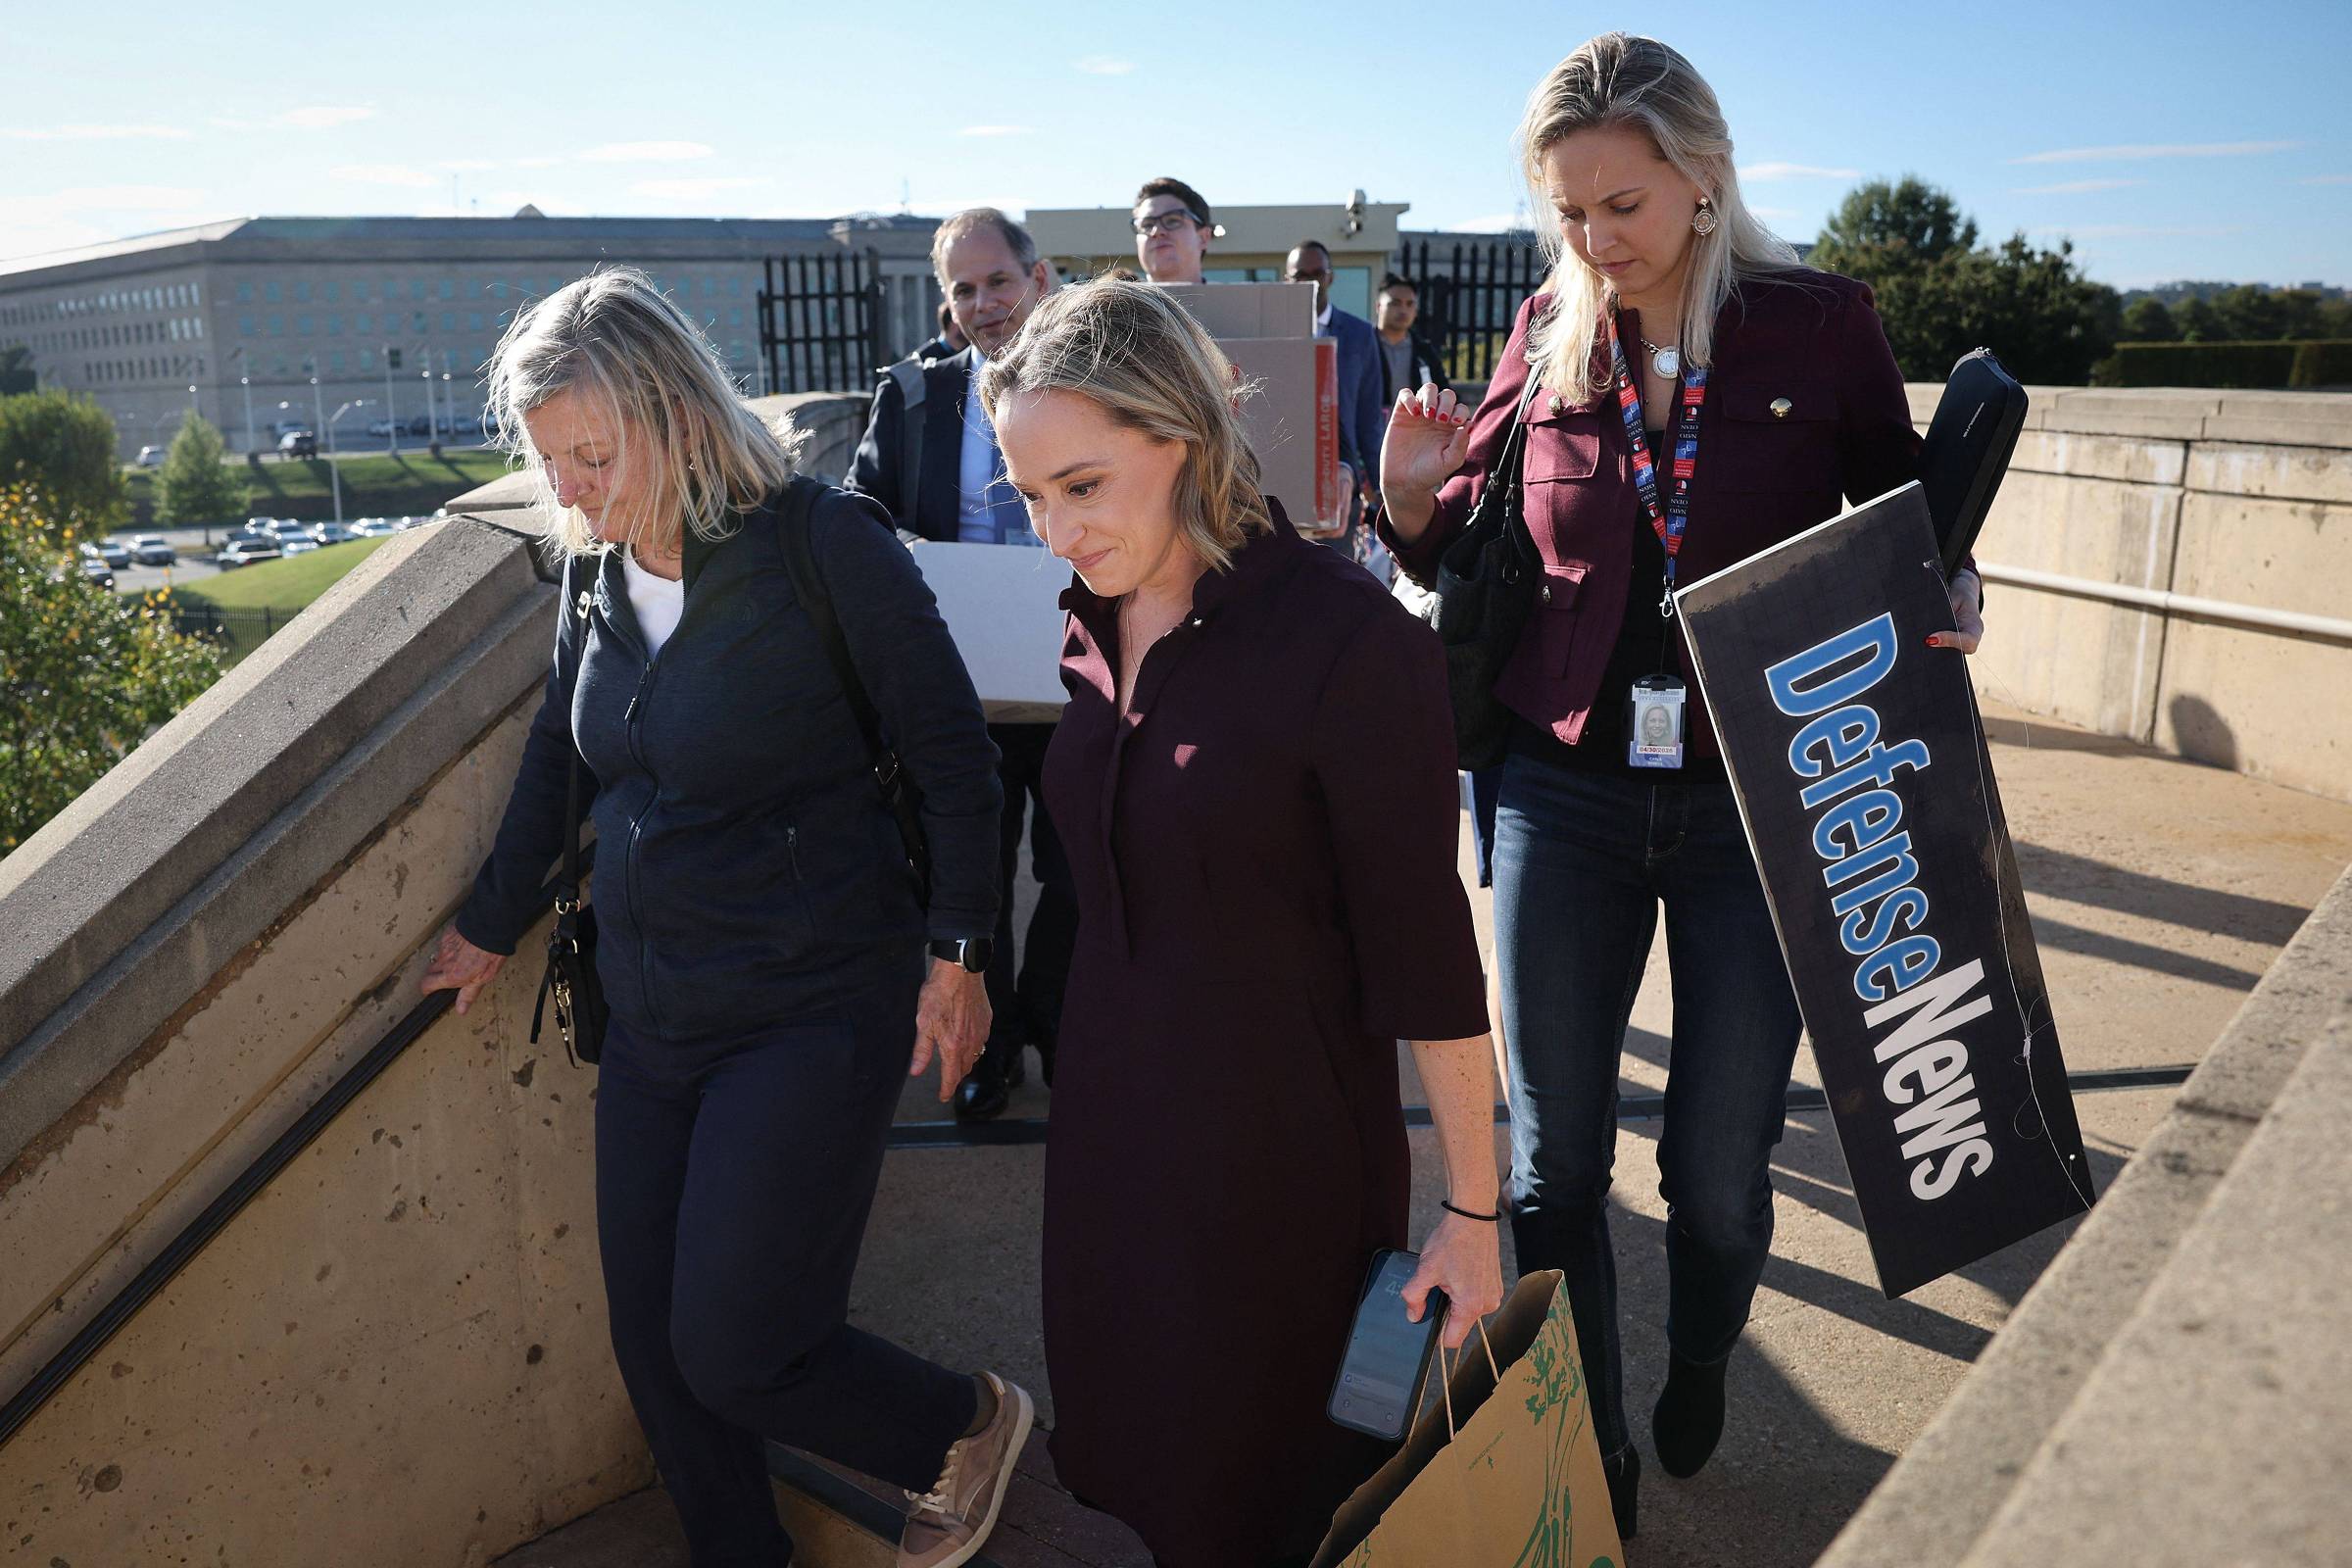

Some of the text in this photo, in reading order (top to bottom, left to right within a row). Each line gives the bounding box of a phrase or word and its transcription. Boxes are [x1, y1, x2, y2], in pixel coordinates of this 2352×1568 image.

[1320, 394, 1332, 440] LARGE
[1639, 483, 1655, 494] NATO
[1641, 492, 1657, 503] OTAN
